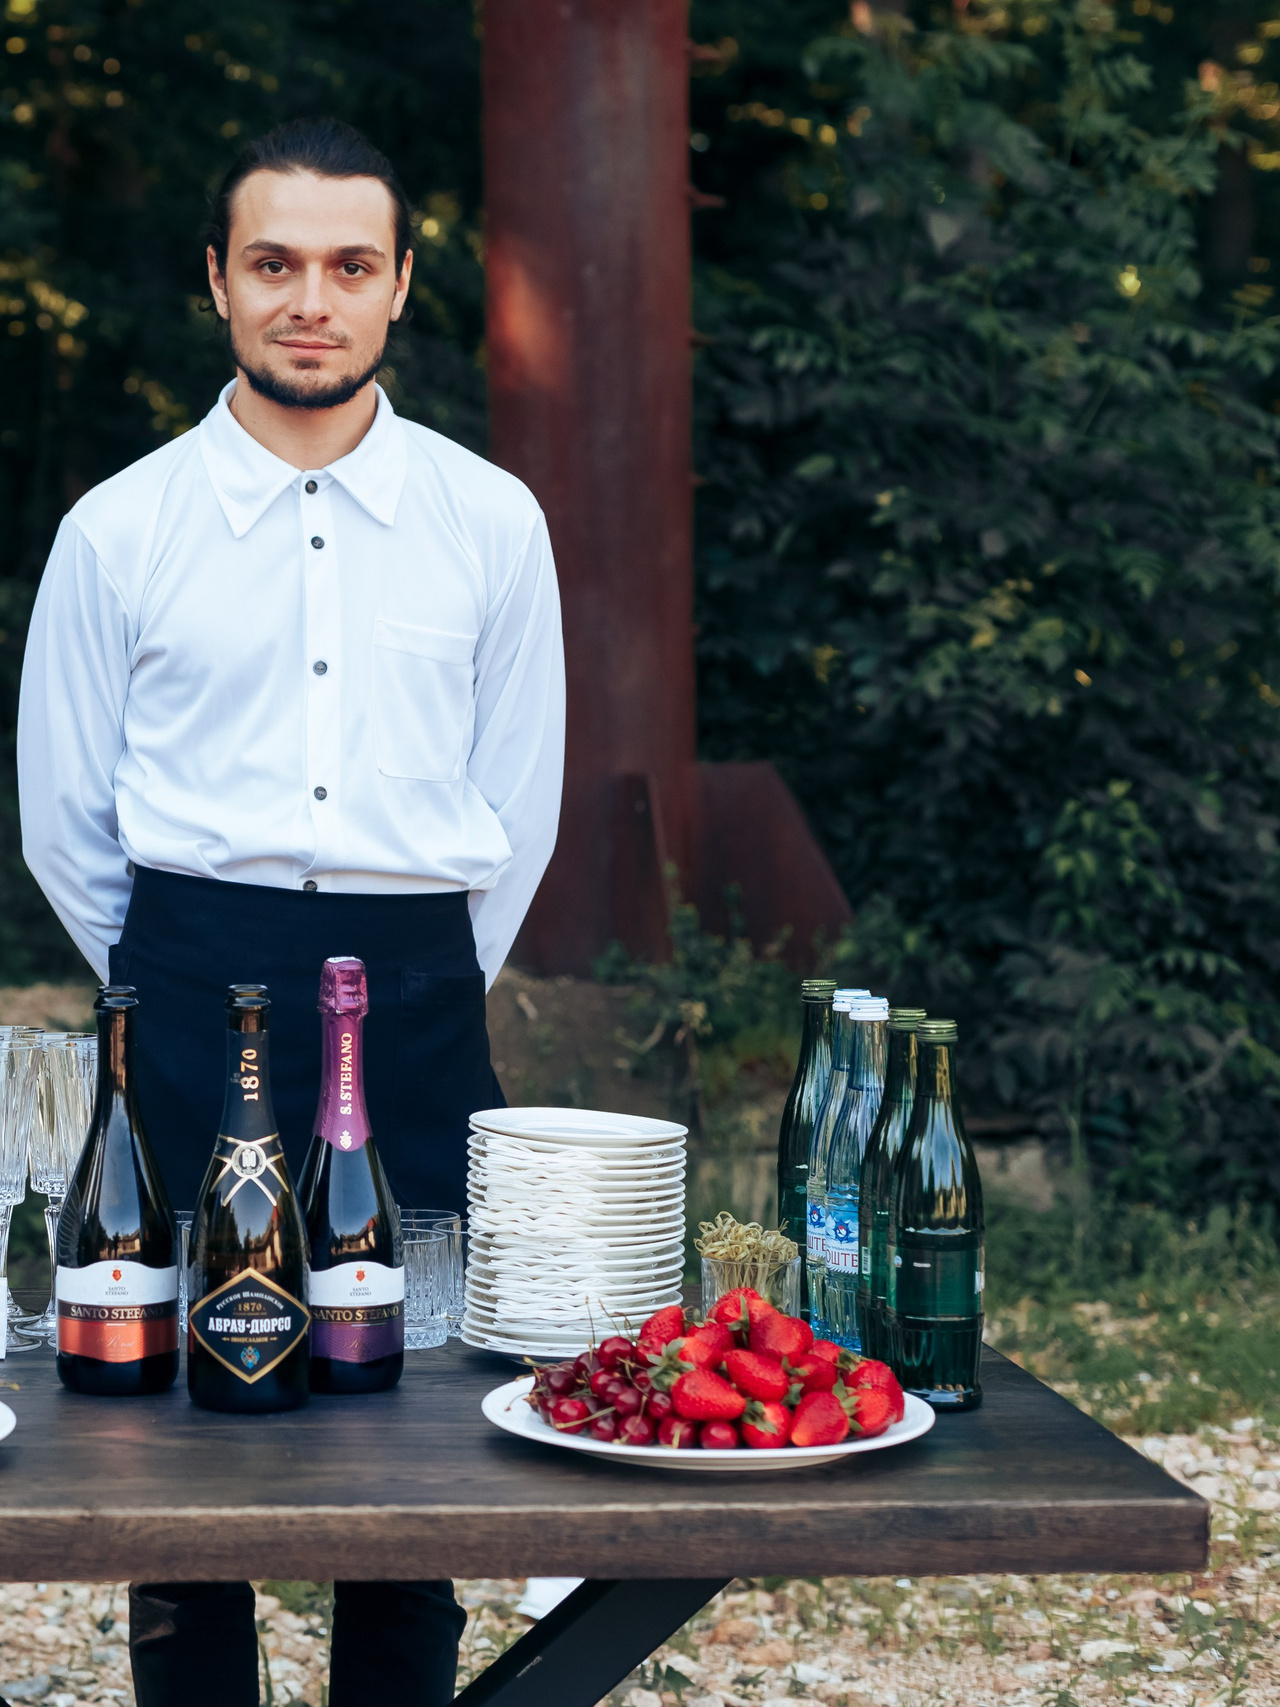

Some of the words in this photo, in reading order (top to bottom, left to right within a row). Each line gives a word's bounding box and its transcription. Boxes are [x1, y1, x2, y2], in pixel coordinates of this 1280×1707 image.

[240, 1048, 259, 1101] 1870
[340, 1032, 353, 1101] STEFANO
[339, 1102, 353, 1115] S.
[70, 1305, 109, 1320] SANTO
[110, 1306, 164, 1320] STEFANO
[237, 1302, 262, 1312] 1870
[312, 1309, 353, 1322] SANTO
[355, 1305, 399, 1322] STEFANO
